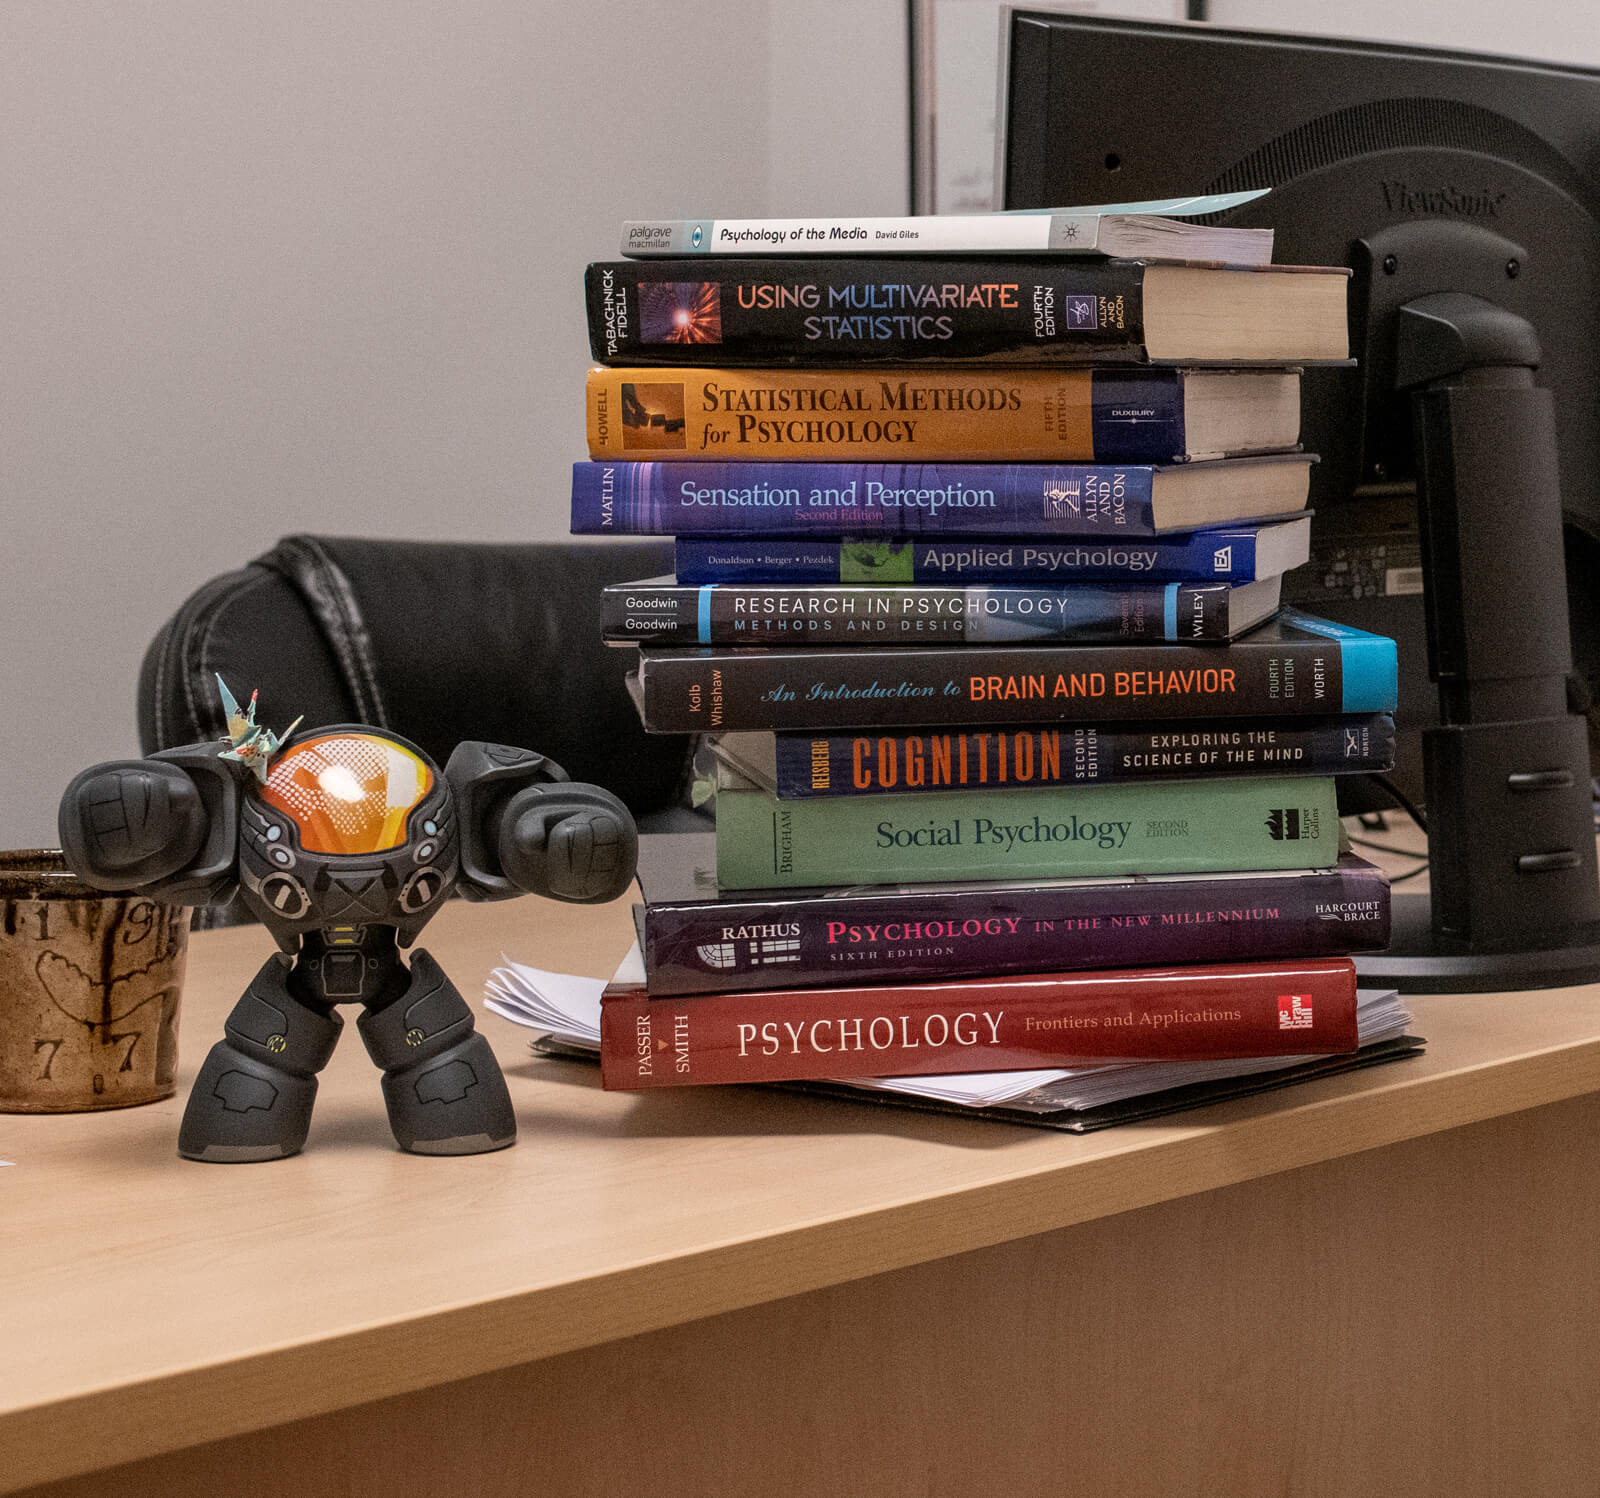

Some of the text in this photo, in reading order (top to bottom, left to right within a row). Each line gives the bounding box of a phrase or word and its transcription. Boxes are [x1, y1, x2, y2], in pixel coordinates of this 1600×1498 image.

[628, 239, 671, 249] macmillan
[629, 226, 672, 240] palgrave
[720, 227, 868, 244] Psychology of the Media
[875, 230, 919, 240] David Giles
[604, 269, 618, 356] TABACHNICK
[617, 287, 628, 339] FIDELL
[737, 284, 1019, 309] USING MULTIVARIATE
[1034, 285, 1045, 337] FOURTH
[1044, 287, 1055, 336] EDITION
[1099, 296, 1108, 328] ALLYN
[1116, 295, 1124, 329] BACON
[803, 316, 953, 340] STATISTICS
[702, 382, 1021, 412] STATISTICAL METHODS
[1044, 396, 1054, 431] FIFTH
[1057, 388, 1067, 440] EDITION
[599, 388, 609, 446] HOWELL
[701, 415, 918, 449] for PSYCHOLOGY
[601, 467, 614, 527] MATLIN
[680, 480, 997, 515] Sensation and Perception
[1087, 475, 1098, 524] ALLYN
[1099, 481, 1111, 515] AND
[1115, 473, 1126, 525] BACON
[795, 509, 884, 522] Second Edition
[708, 555, 834, 567] Donaldson Berger Pezdek
[924, 548, 1158, 572] Applied Psychology
[626, 597, 678, 609] Goodwin
[735, 598, 1068, 614] RESEARCH IN PSYCHOLOGY
[1192, 592, 1204, 638] WILEY
[625, 619, 678, 631] Goodwin
[734, 620, 978, 630] METHODS AND DESIGN
[760, 669, 1236, 702] An Introduction to BRAIN AND BEHAVIOR
[1269, 659, 1279, 699] FOURTH
[1285, 658, 1294, 698] EDITION
[1315, 658, 1324, 699] WORTH
[689, 684, 701, 712] Kolb
[711, 669, 723, 726] Whishaw
[1075, 729, 1085, 778] SECOND
[1088, 729, 1097, 778] EDITION
[1151, 731, 1276, 747] EXPLORING THE
[811, 740, 829, 789] REISBERG
[853, 730, 1060, 789] COGNITION
[1123, 748, 1304, 767] SCIENCE OF THE MIND
[876, 814, 1132, 853] Social Psychology
[1146, 820, 1189, 829] SECOND
[1146, 828, 1189, 838] EDITION
[1301, 809, 1309, 839] Harper
[1310, 808, 1319, 839] Collins
[780, 811, 792, 874] BRIGHAM
[123, 902, 156, 944] 9
[1315, 901, 1380, 914] HARCOURT
[1343, 910, 1380, 922] BRACE
[721, 922, 800, 940] RATHUS
[826, 908, 1280, 944] PSYCHOLOGY IN THE NEW MILLENNIUM
[830, 947, 955, 961] SIXTH EDITION
[737, 1010, 1004, 1057] PSYCHOLOGY
[1025, 1008, 1242, 1031] Frontiers and Applications
[1279, 1010, 1290, 1030] Mc
[33, 1031, 141, 1081] 7 7
[638, 1014, 652, 1076] PASSER
[676, 1014, 690, 1073] SMITH
